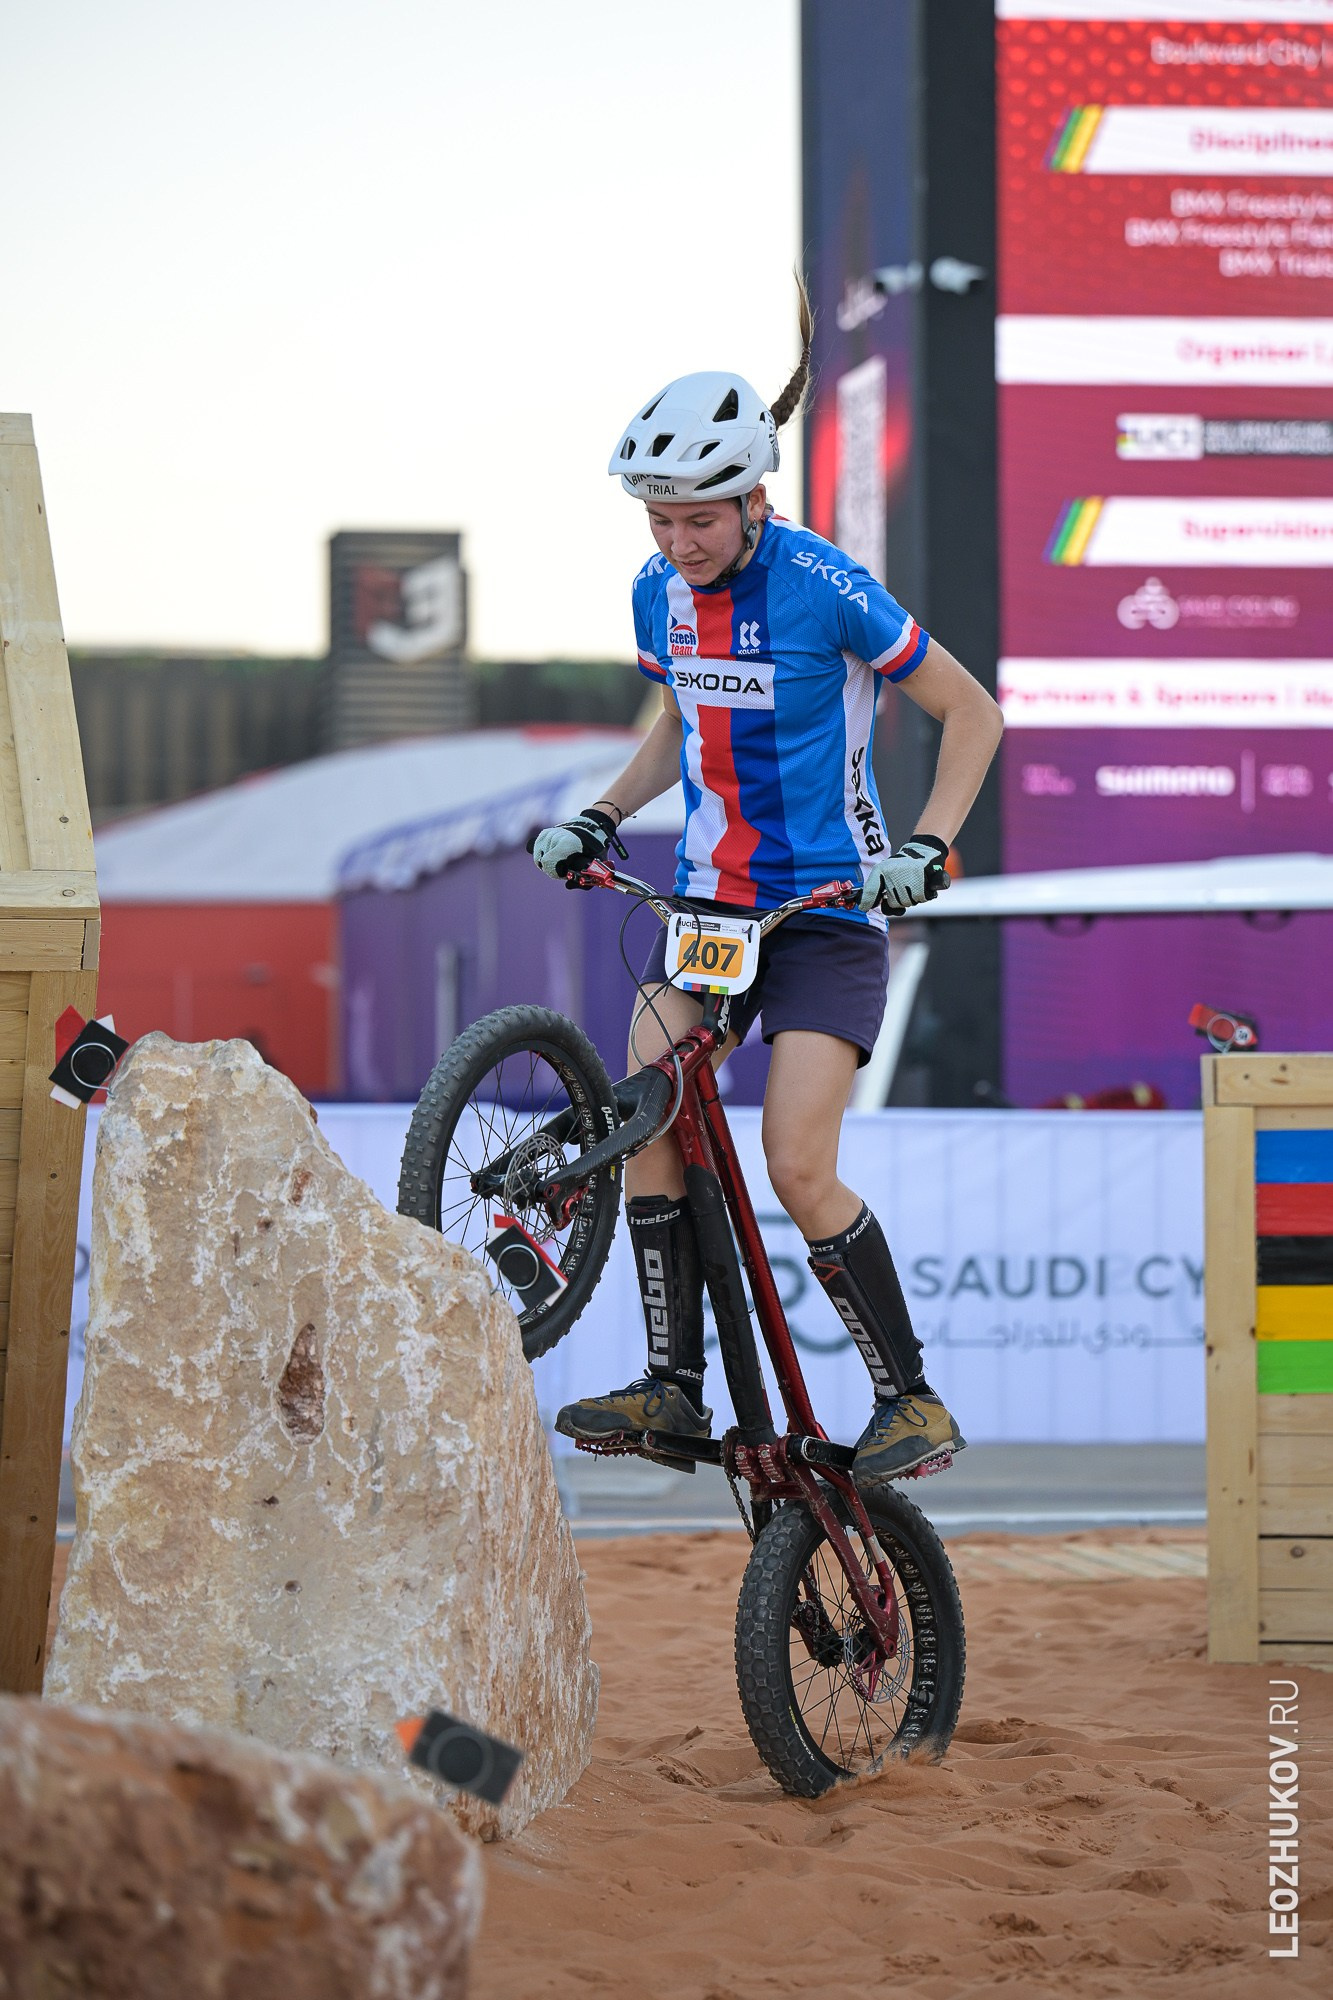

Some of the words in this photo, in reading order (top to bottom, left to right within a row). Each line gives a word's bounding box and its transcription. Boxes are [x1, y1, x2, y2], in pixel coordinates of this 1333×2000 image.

[647, 484, 678, 495] TRIAL
[670, 632, 696, 645] czech
[671, 644, 693, 655] team
[683, 940, 739, 972] 407
[630, 1209, 681, 1225] hebo
[911, 1256, 1106, 1299] SAUDI
[644, 1248, 669, 1366] hebo
[832, 1296, 899, 1396] hebo
